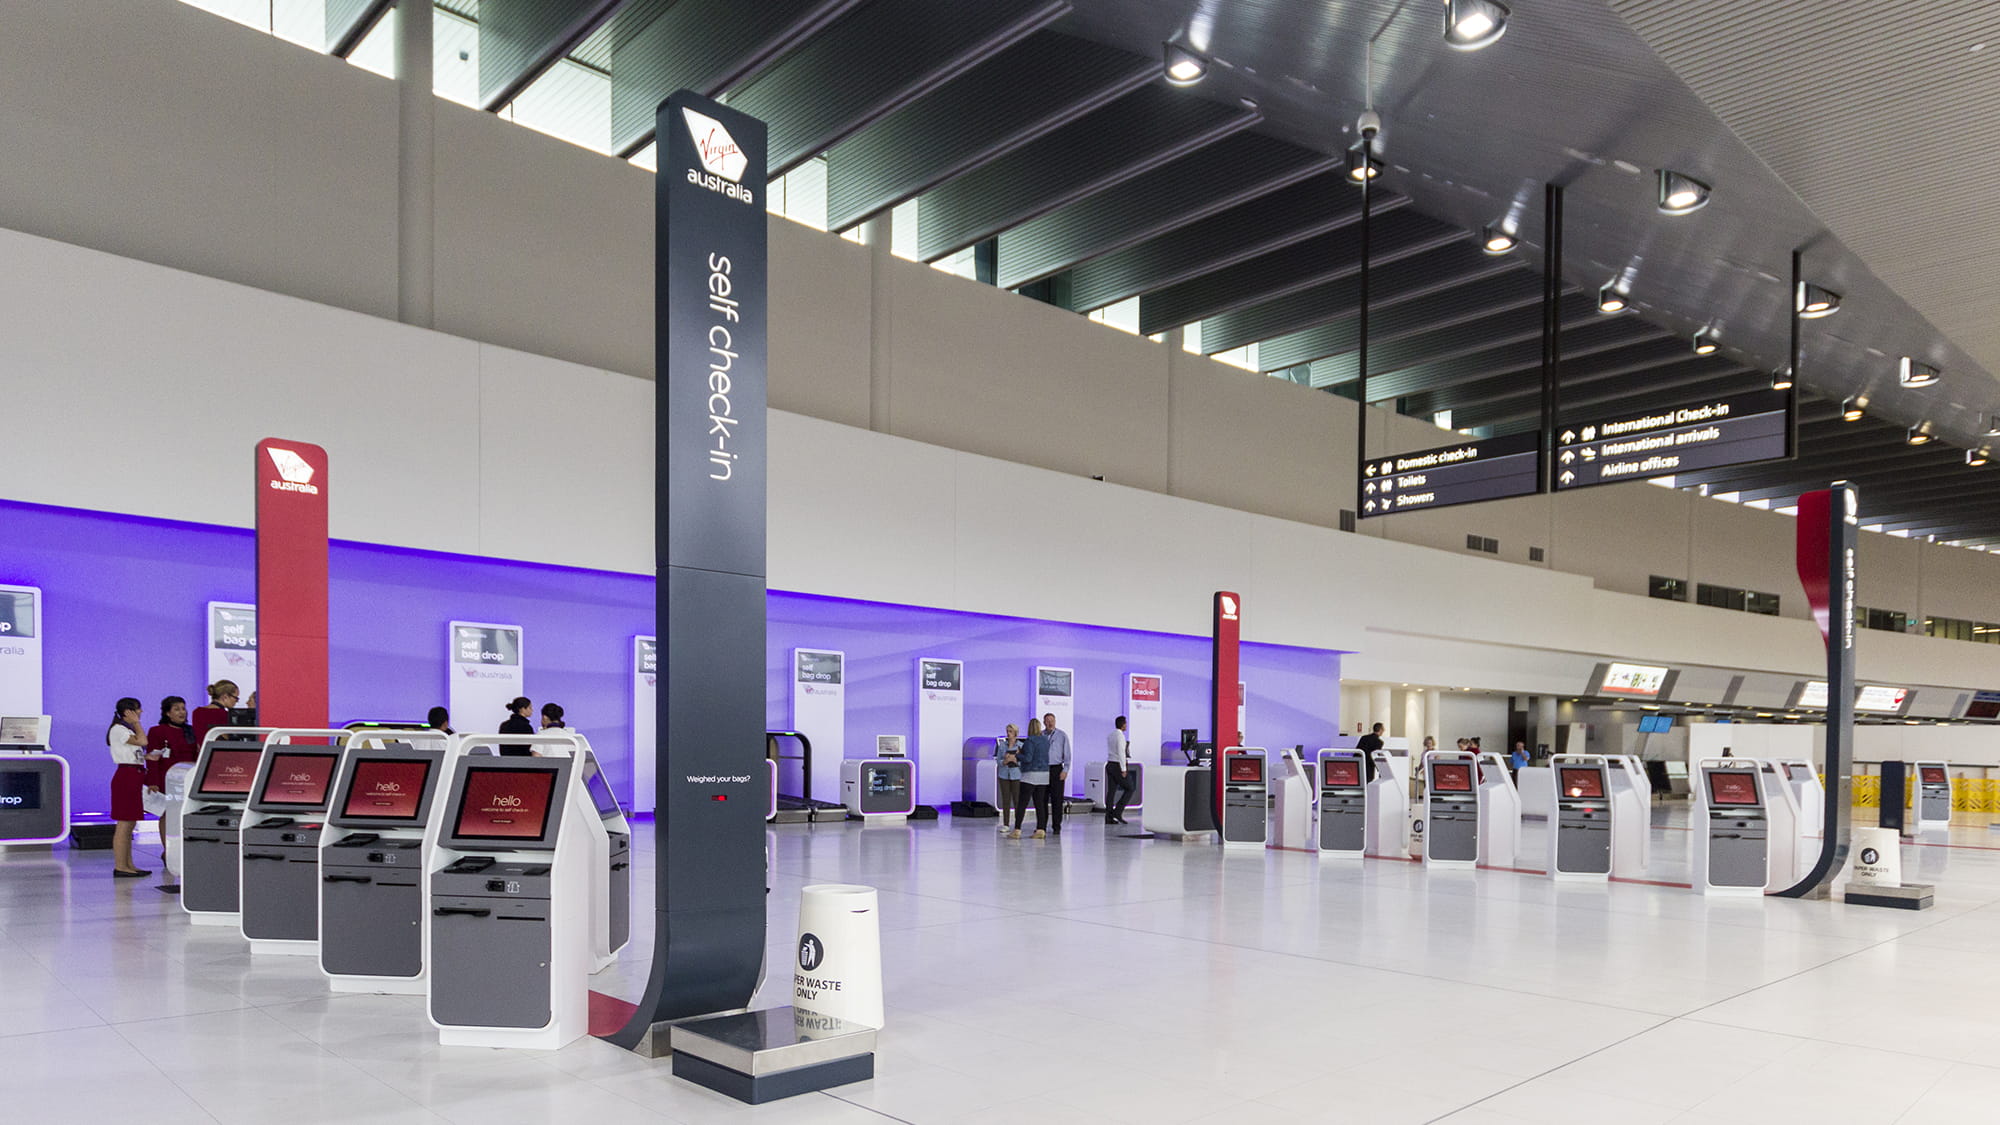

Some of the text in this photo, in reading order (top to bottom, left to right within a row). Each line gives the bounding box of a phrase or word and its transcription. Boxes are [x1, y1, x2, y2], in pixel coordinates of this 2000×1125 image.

[700, 127, 739, 171] Virgin
[687, 168, 753, 204] australia
[708, 252, 739, 481] self check-in
[1601, 403, 1729, 436] International Check-in
[1601, 426, 1720, 456] International arrivals
[1396, 447, 1478, 471] Domestic check-in
[1601, 456, 1680, 477] Airline offices
[270, 479, 319, 495] australia
[1398, 474, 1427, 488] Toilets
[1396, 492, 1435, 506] Showers
[223, 623, 245, 634] self
[223, 634, 247, 647] bag
[461, 640, 478, 650] self
[461, 649, 504, 662] bag drop
[801, 671, 832, 680] bag drop
[926, 680, 952, 688] bag drop
[290, 772, 311, 782] hello
[686, 774, 751, 784] Weighed your bags?
[376, 781, 400, 792] hello
[0, 795, 23, 805] rop
[492, 794, 522, 807] hello
[806, 977, 841, 991] WASTE
[796, 987, 818, 1000] ONLY
